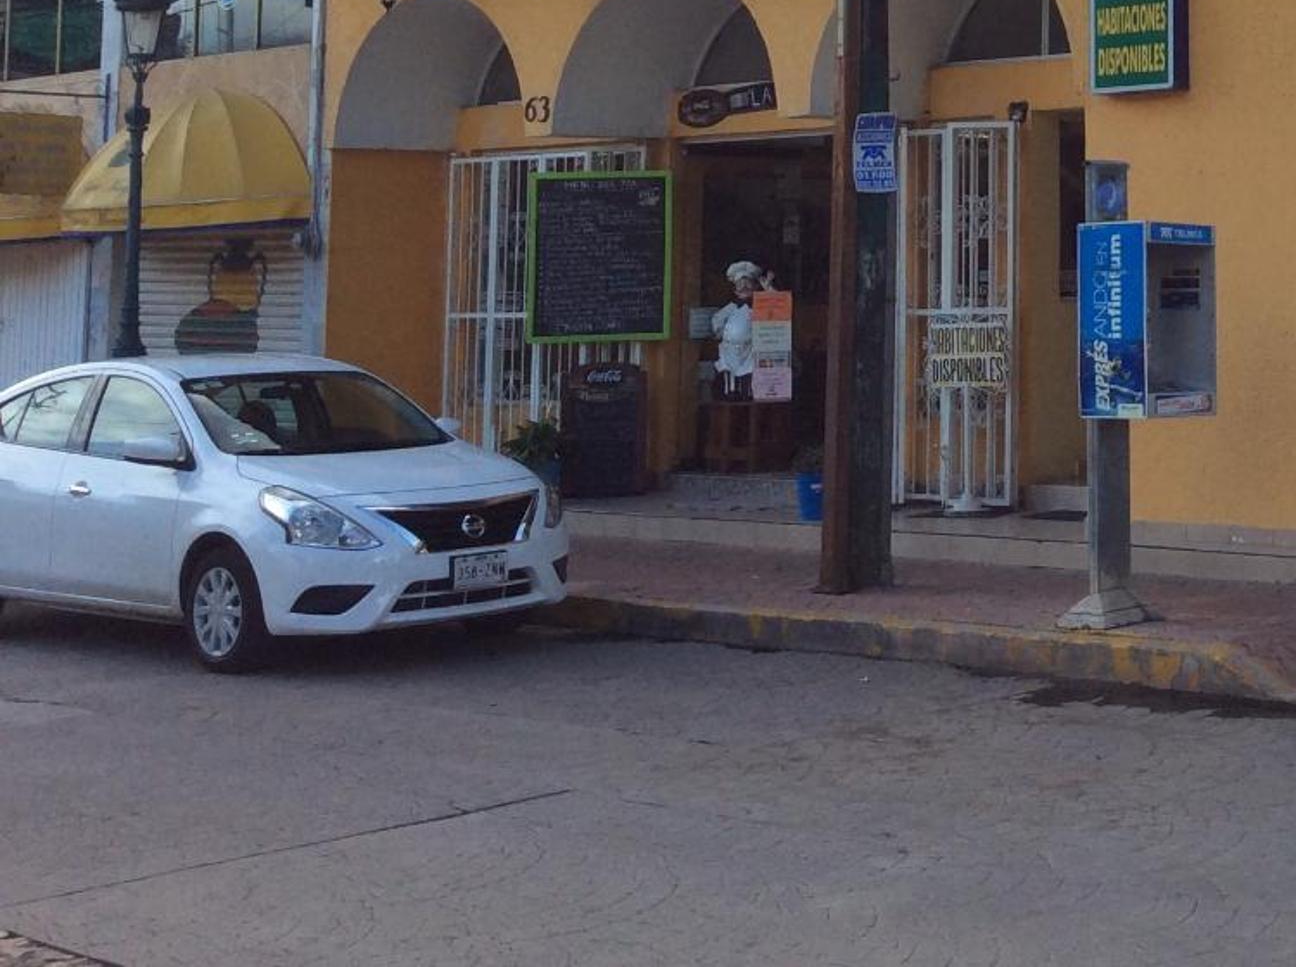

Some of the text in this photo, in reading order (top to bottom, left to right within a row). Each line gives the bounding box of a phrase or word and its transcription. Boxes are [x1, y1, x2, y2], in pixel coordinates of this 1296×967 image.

[1097, 1, 1166, 36] HABITACIONES
[1098, 42, 1166, 76] DISPONIBLES
[524, 95, 550, 123] 63
[1107, 233, 1123, 340] infinitum
